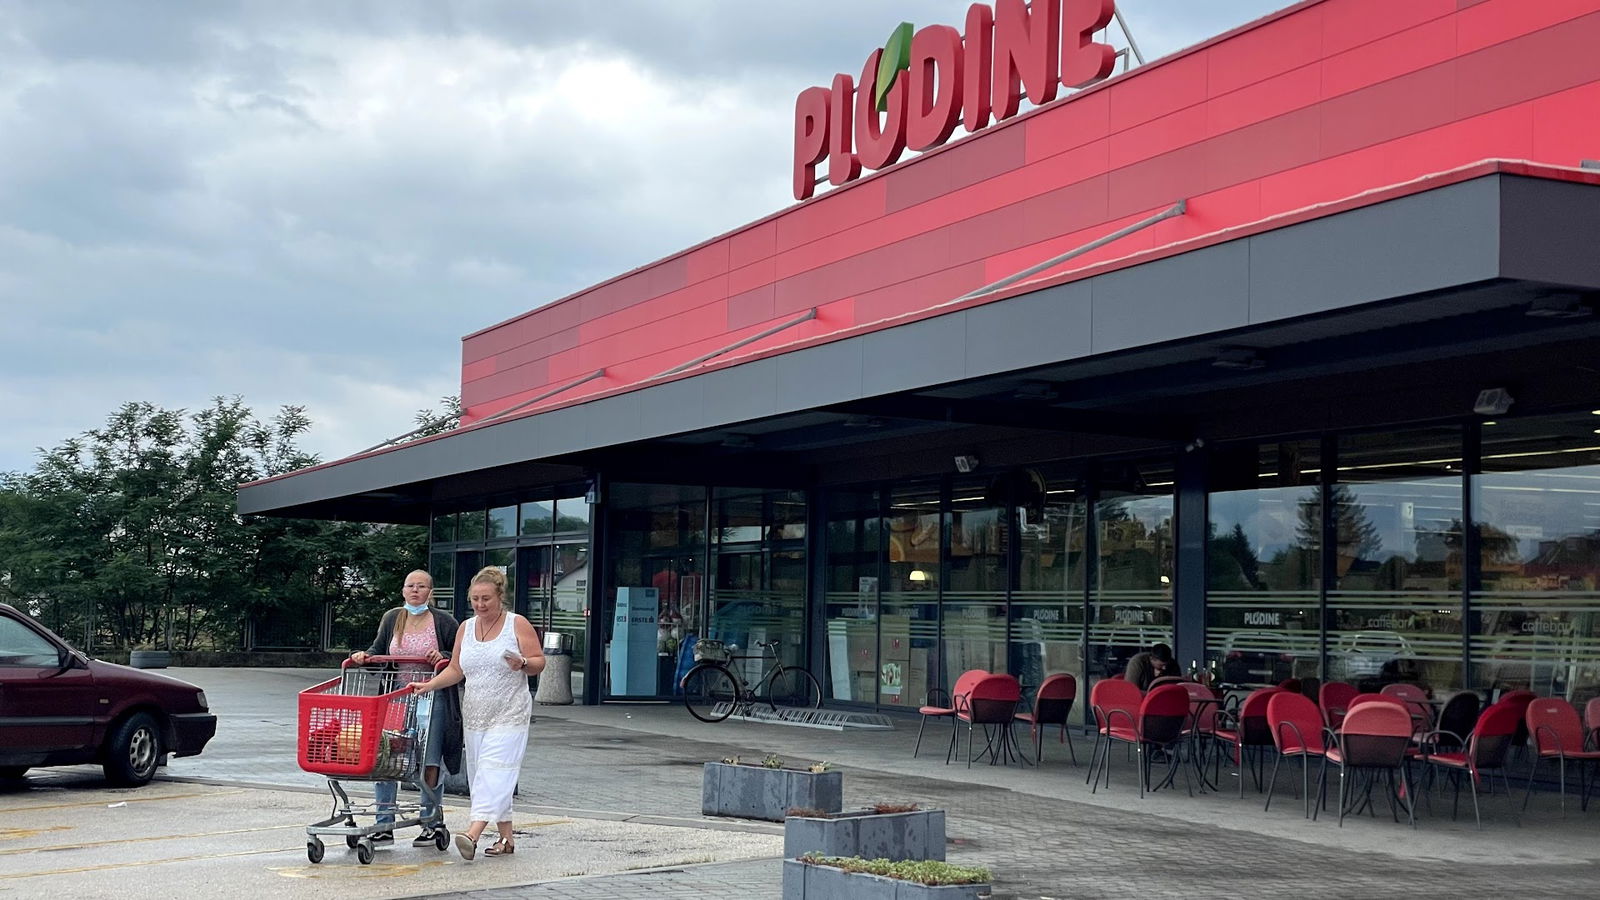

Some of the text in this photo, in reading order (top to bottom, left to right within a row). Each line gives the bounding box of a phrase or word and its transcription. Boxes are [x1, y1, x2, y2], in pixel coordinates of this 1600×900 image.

[793, 0, 1116, 201] PLODINE
[1033, 608, 1060, 621] PLODINE
[1114, 609, 1145, 622] PLODINE
[1243, 611, 1281, 626] PLODINE
